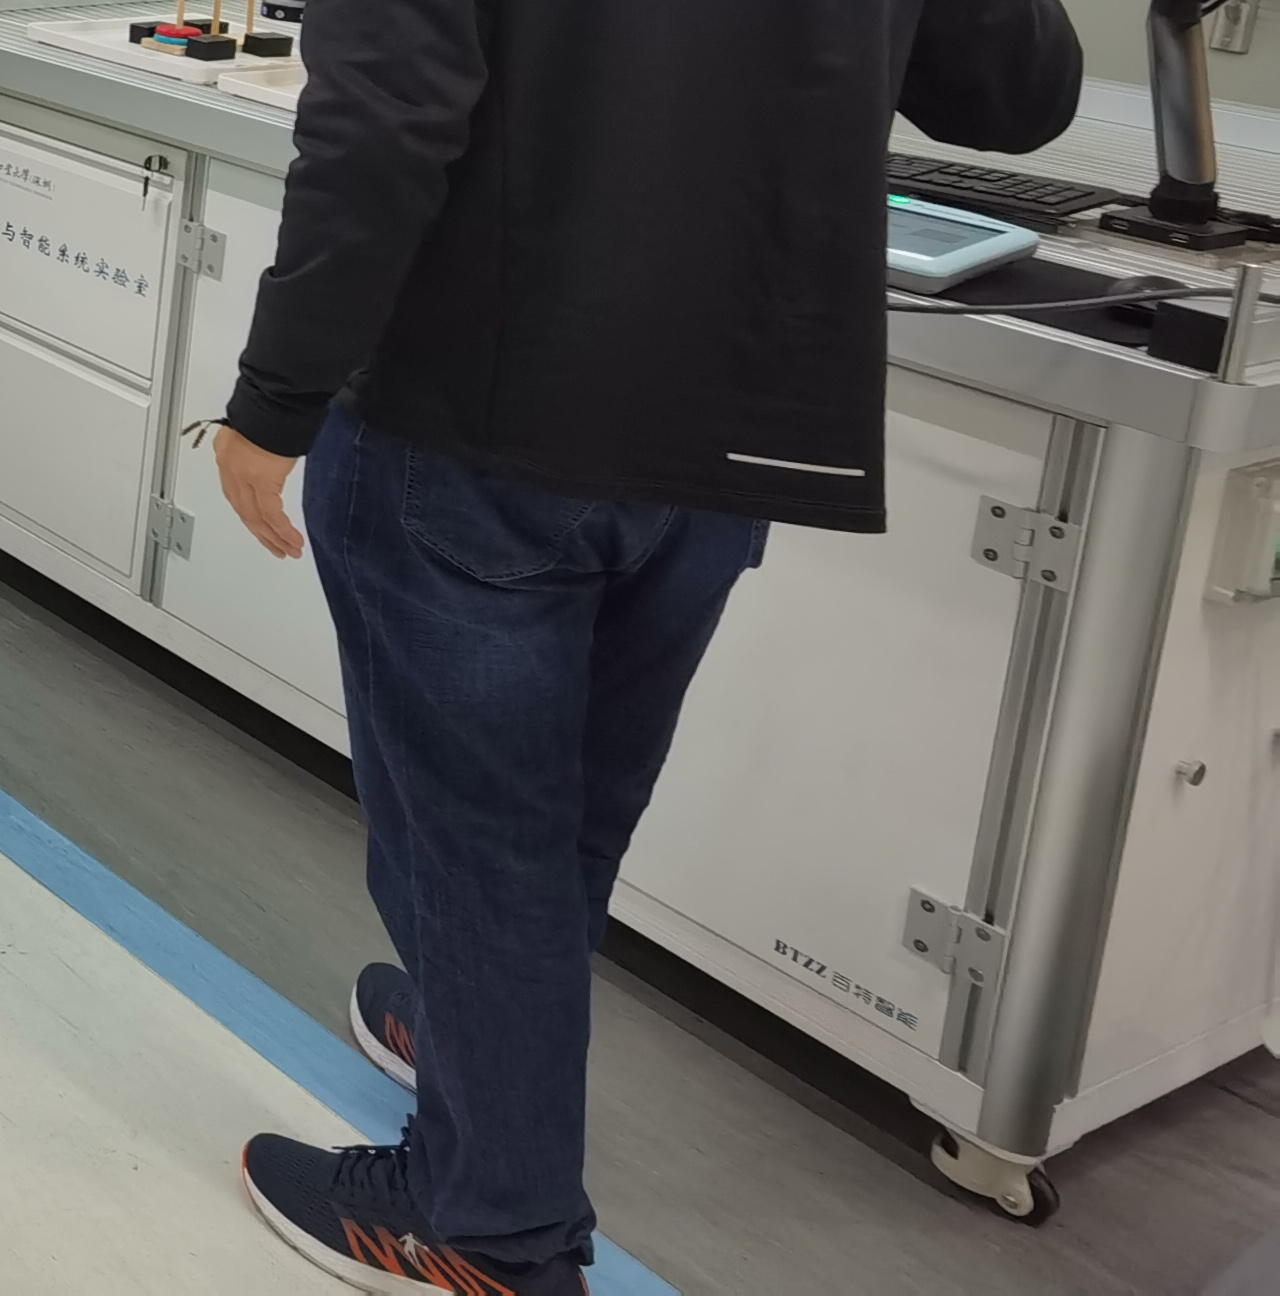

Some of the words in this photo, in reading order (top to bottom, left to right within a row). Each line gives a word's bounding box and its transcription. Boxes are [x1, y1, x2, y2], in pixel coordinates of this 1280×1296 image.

[773, 938, 828, 979] BTZZ
[830, 970, 919, 1031] 百特智能
